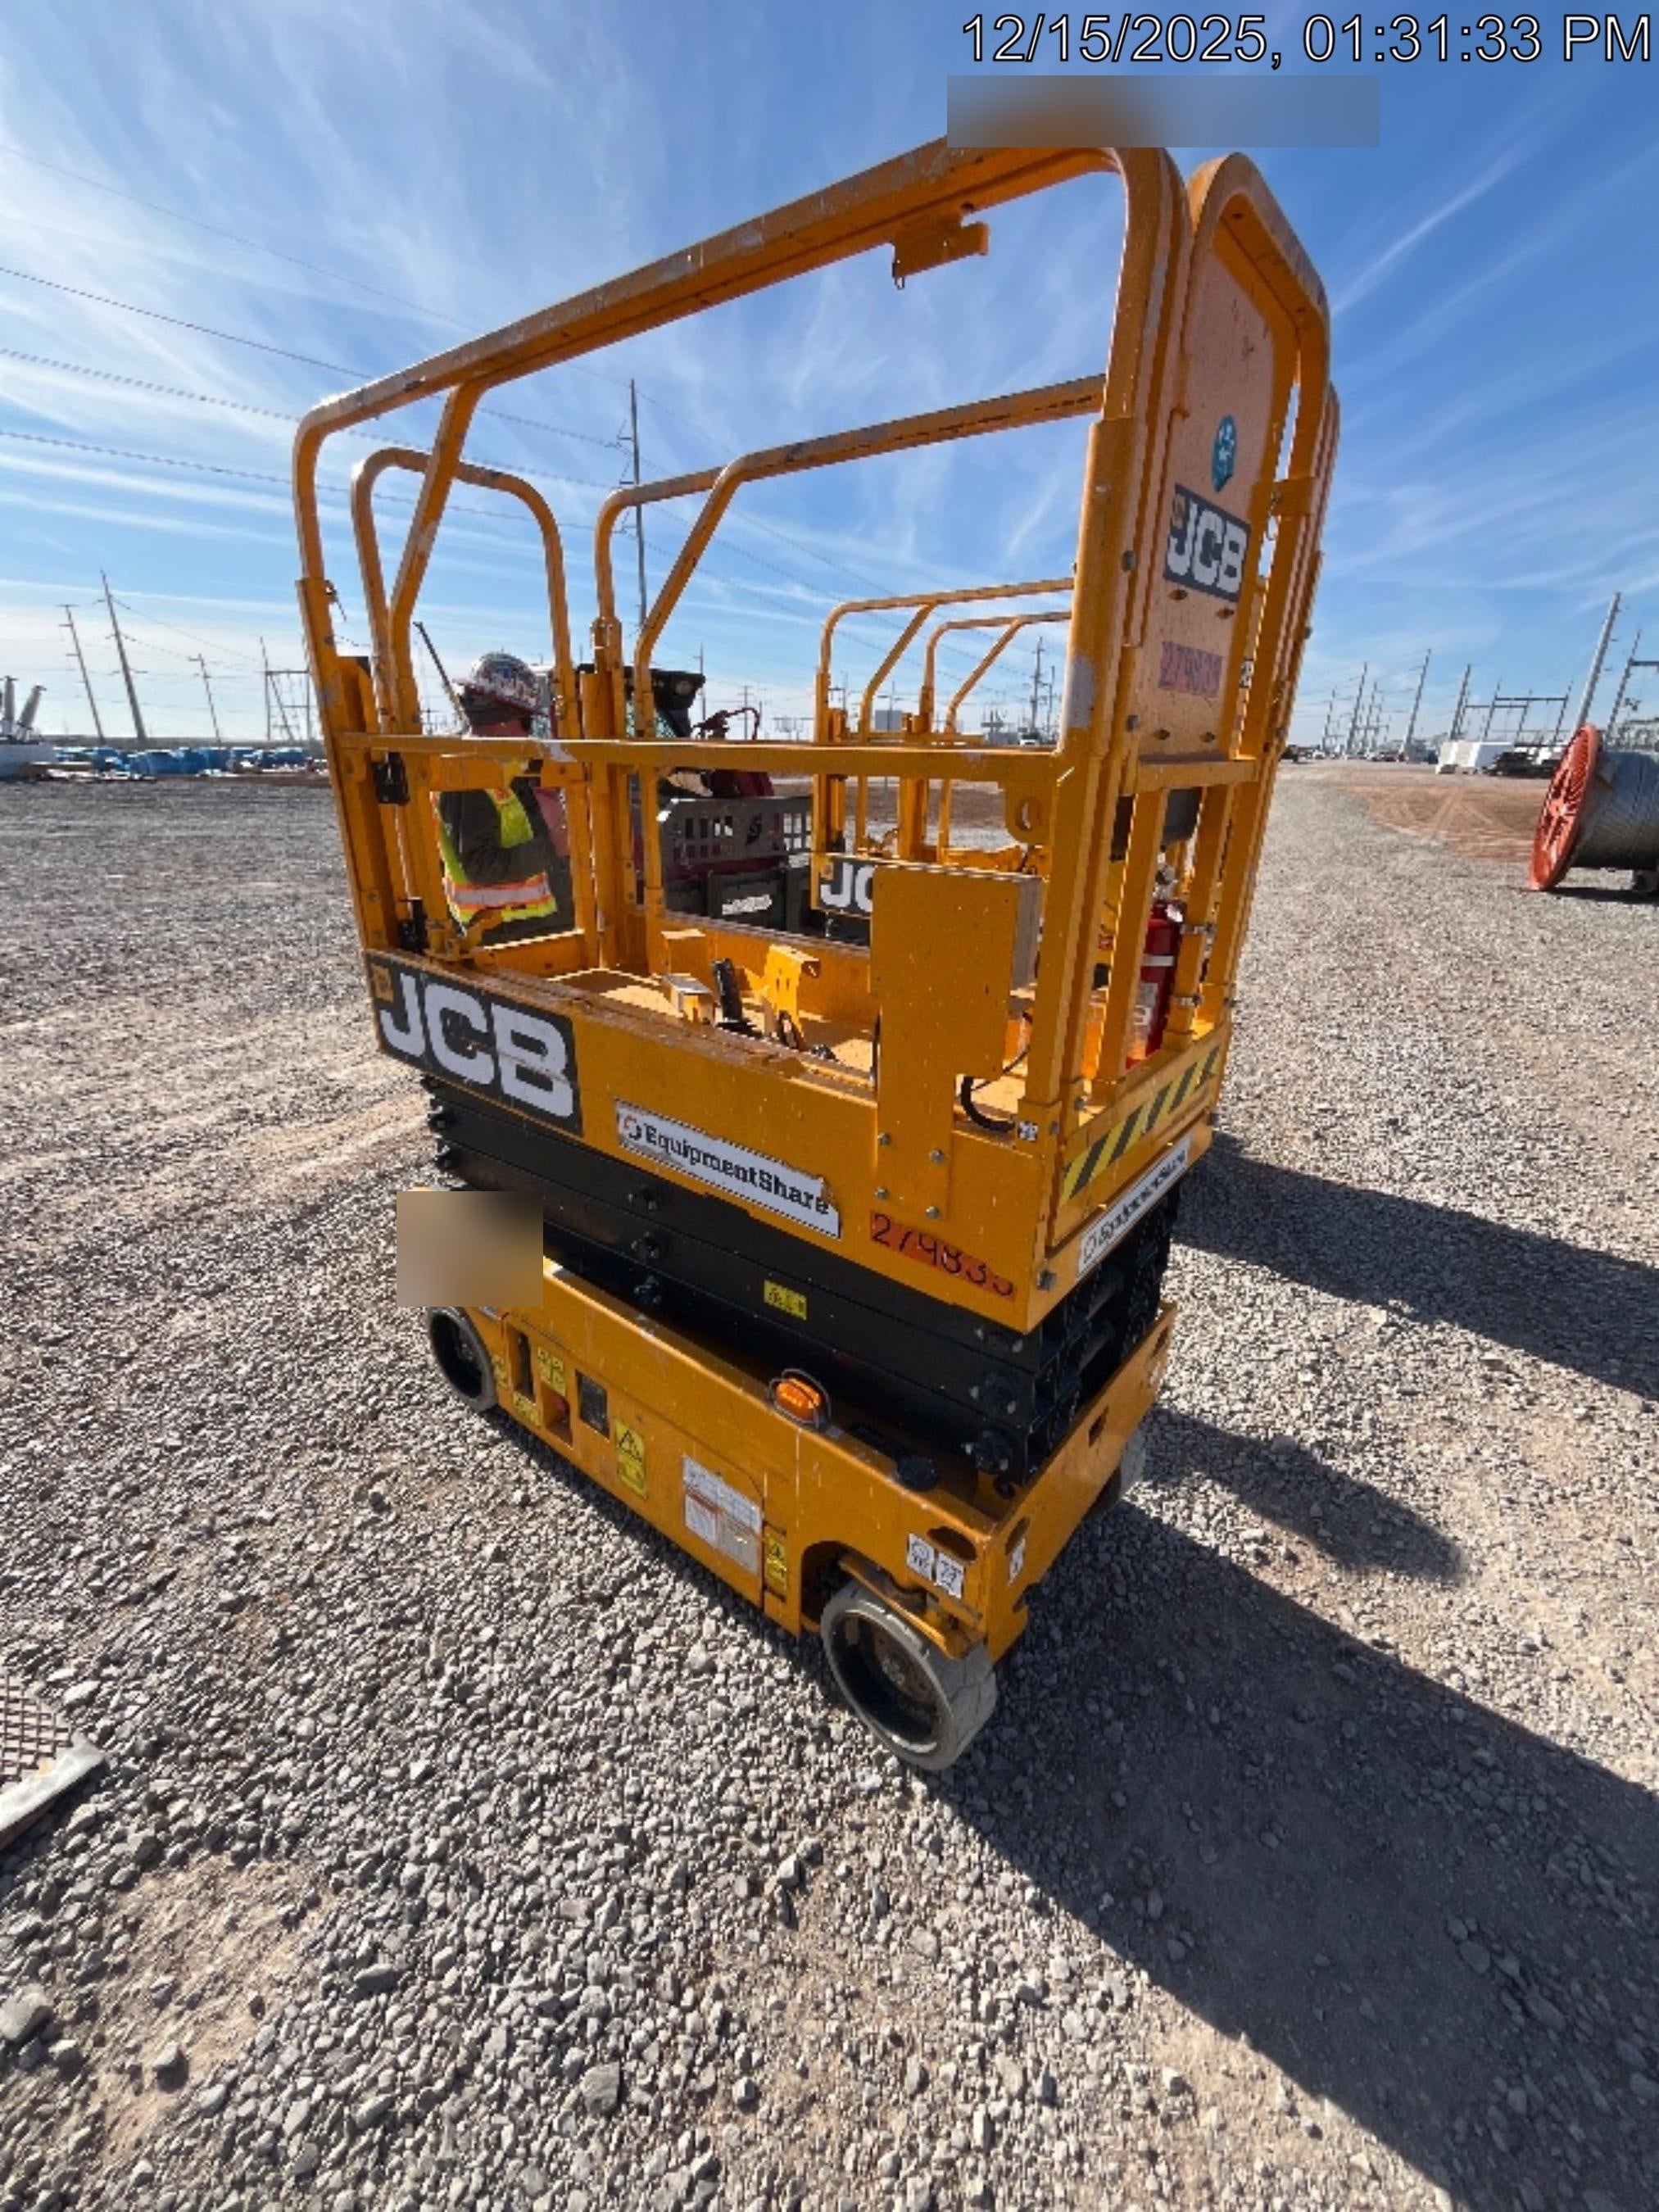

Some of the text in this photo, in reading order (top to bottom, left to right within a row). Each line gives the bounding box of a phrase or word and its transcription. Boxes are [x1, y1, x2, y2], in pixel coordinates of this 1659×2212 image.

[1167, 498, 1249, 595] JCB
[820, 862, 874, 913] JC
[379, 972, 575, 1119] JCB
[645, 1123, 829, 1215] EquipmentShare
